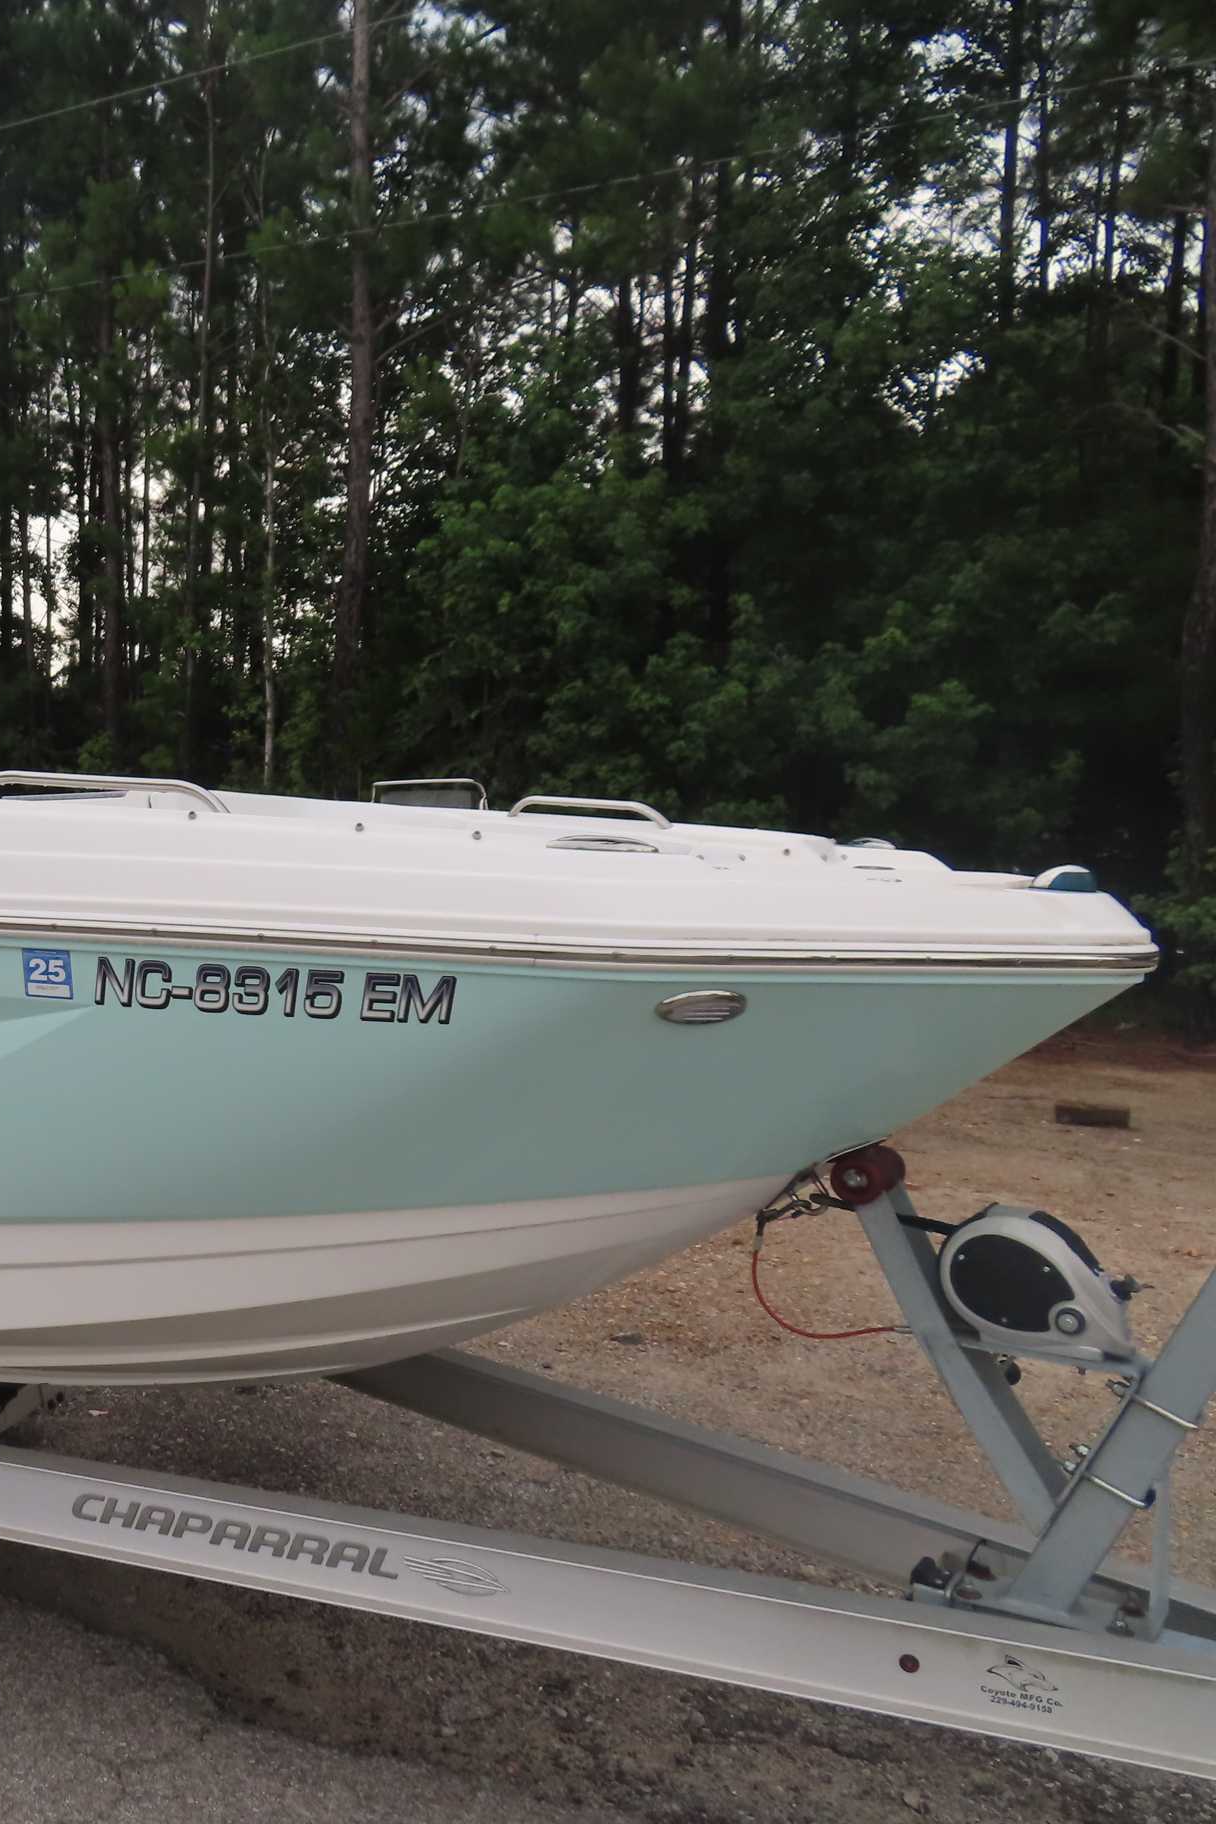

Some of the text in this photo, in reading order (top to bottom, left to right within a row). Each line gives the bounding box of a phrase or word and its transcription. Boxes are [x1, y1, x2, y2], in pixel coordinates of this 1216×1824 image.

[29, 958, 66, 983] 25
[94, 956, 457, 1025] NC-8315 EM
[71, 1492, 399, 1580] CHAPARRAL
[980, 1685, 1017, 1698] Coyote
[1019, 1692, 1043, 1703] MFG
